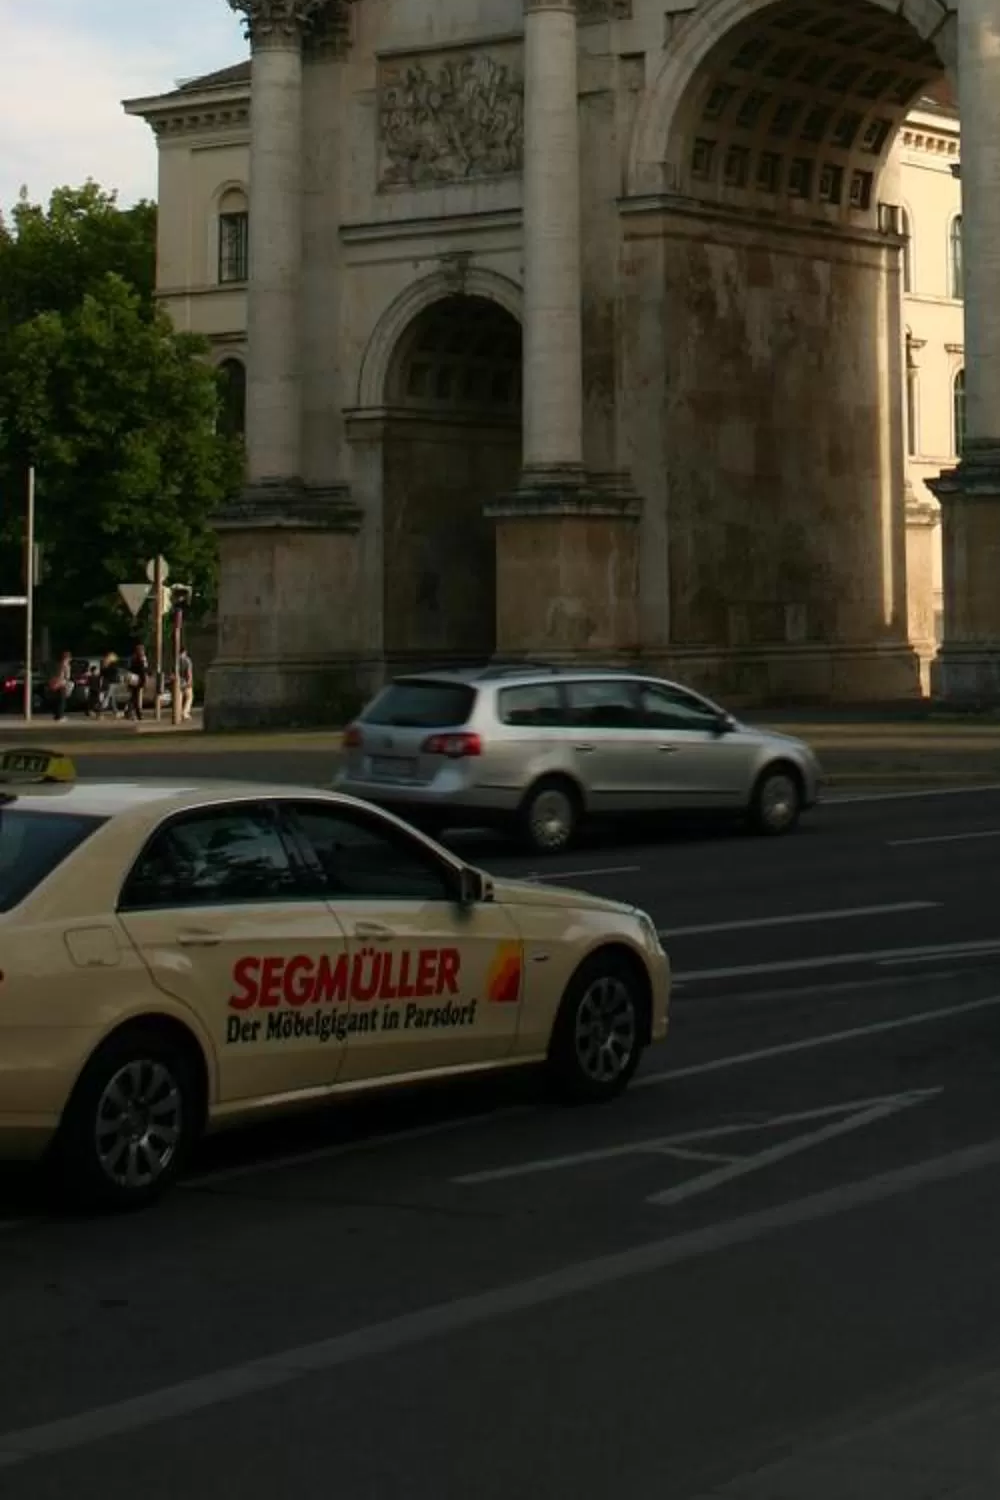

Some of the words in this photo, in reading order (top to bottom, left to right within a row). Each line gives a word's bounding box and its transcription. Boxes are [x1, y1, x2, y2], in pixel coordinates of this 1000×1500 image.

[229, 947, 460, 1009] SEGMÜLLER
[227, 1015, 261, 1044] Der
[266, 1005, 379, 1042] Möbelgigant
[381, 1004, 399, 1031] in
[404, 999, 477, 1029] Parsdorf
